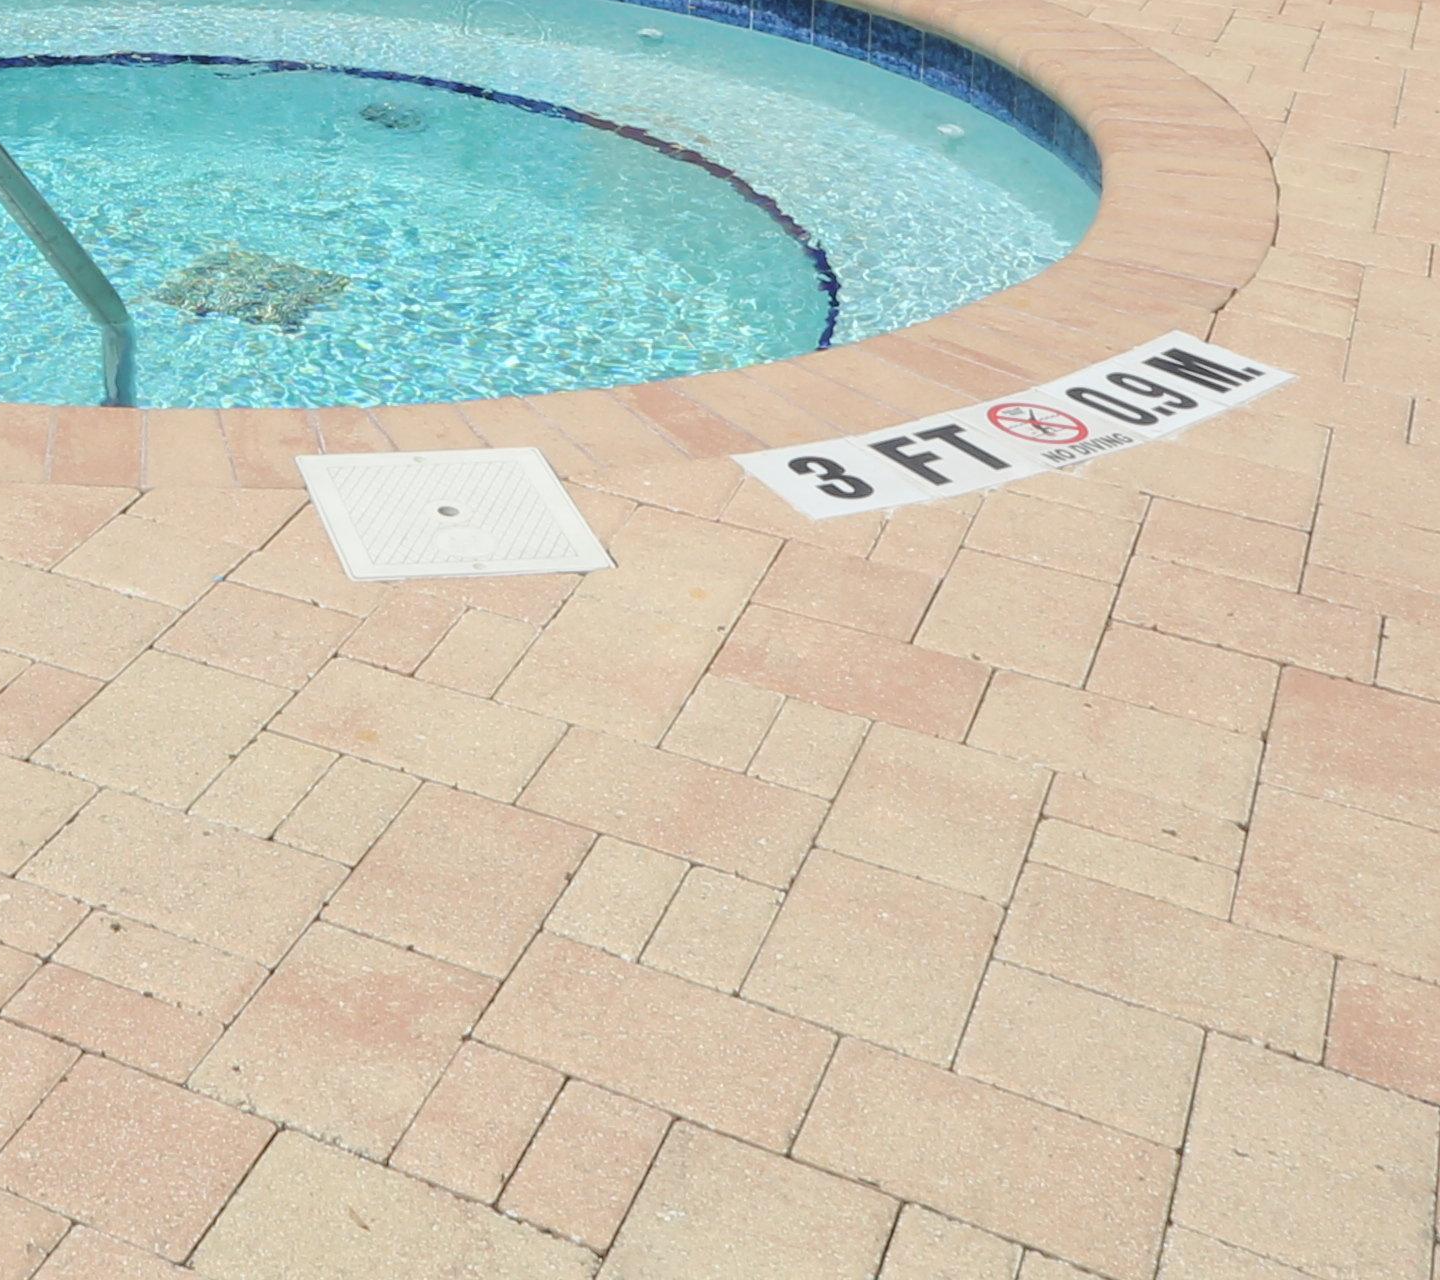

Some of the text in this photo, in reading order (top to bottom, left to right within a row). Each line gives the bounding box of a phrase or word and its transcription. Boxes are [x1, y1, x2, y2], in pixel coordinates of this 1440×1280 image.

[788, 348, 1266, 499] 3 FT 0.9 M.
[1042, 432, 1133, 463] NO DIVING
